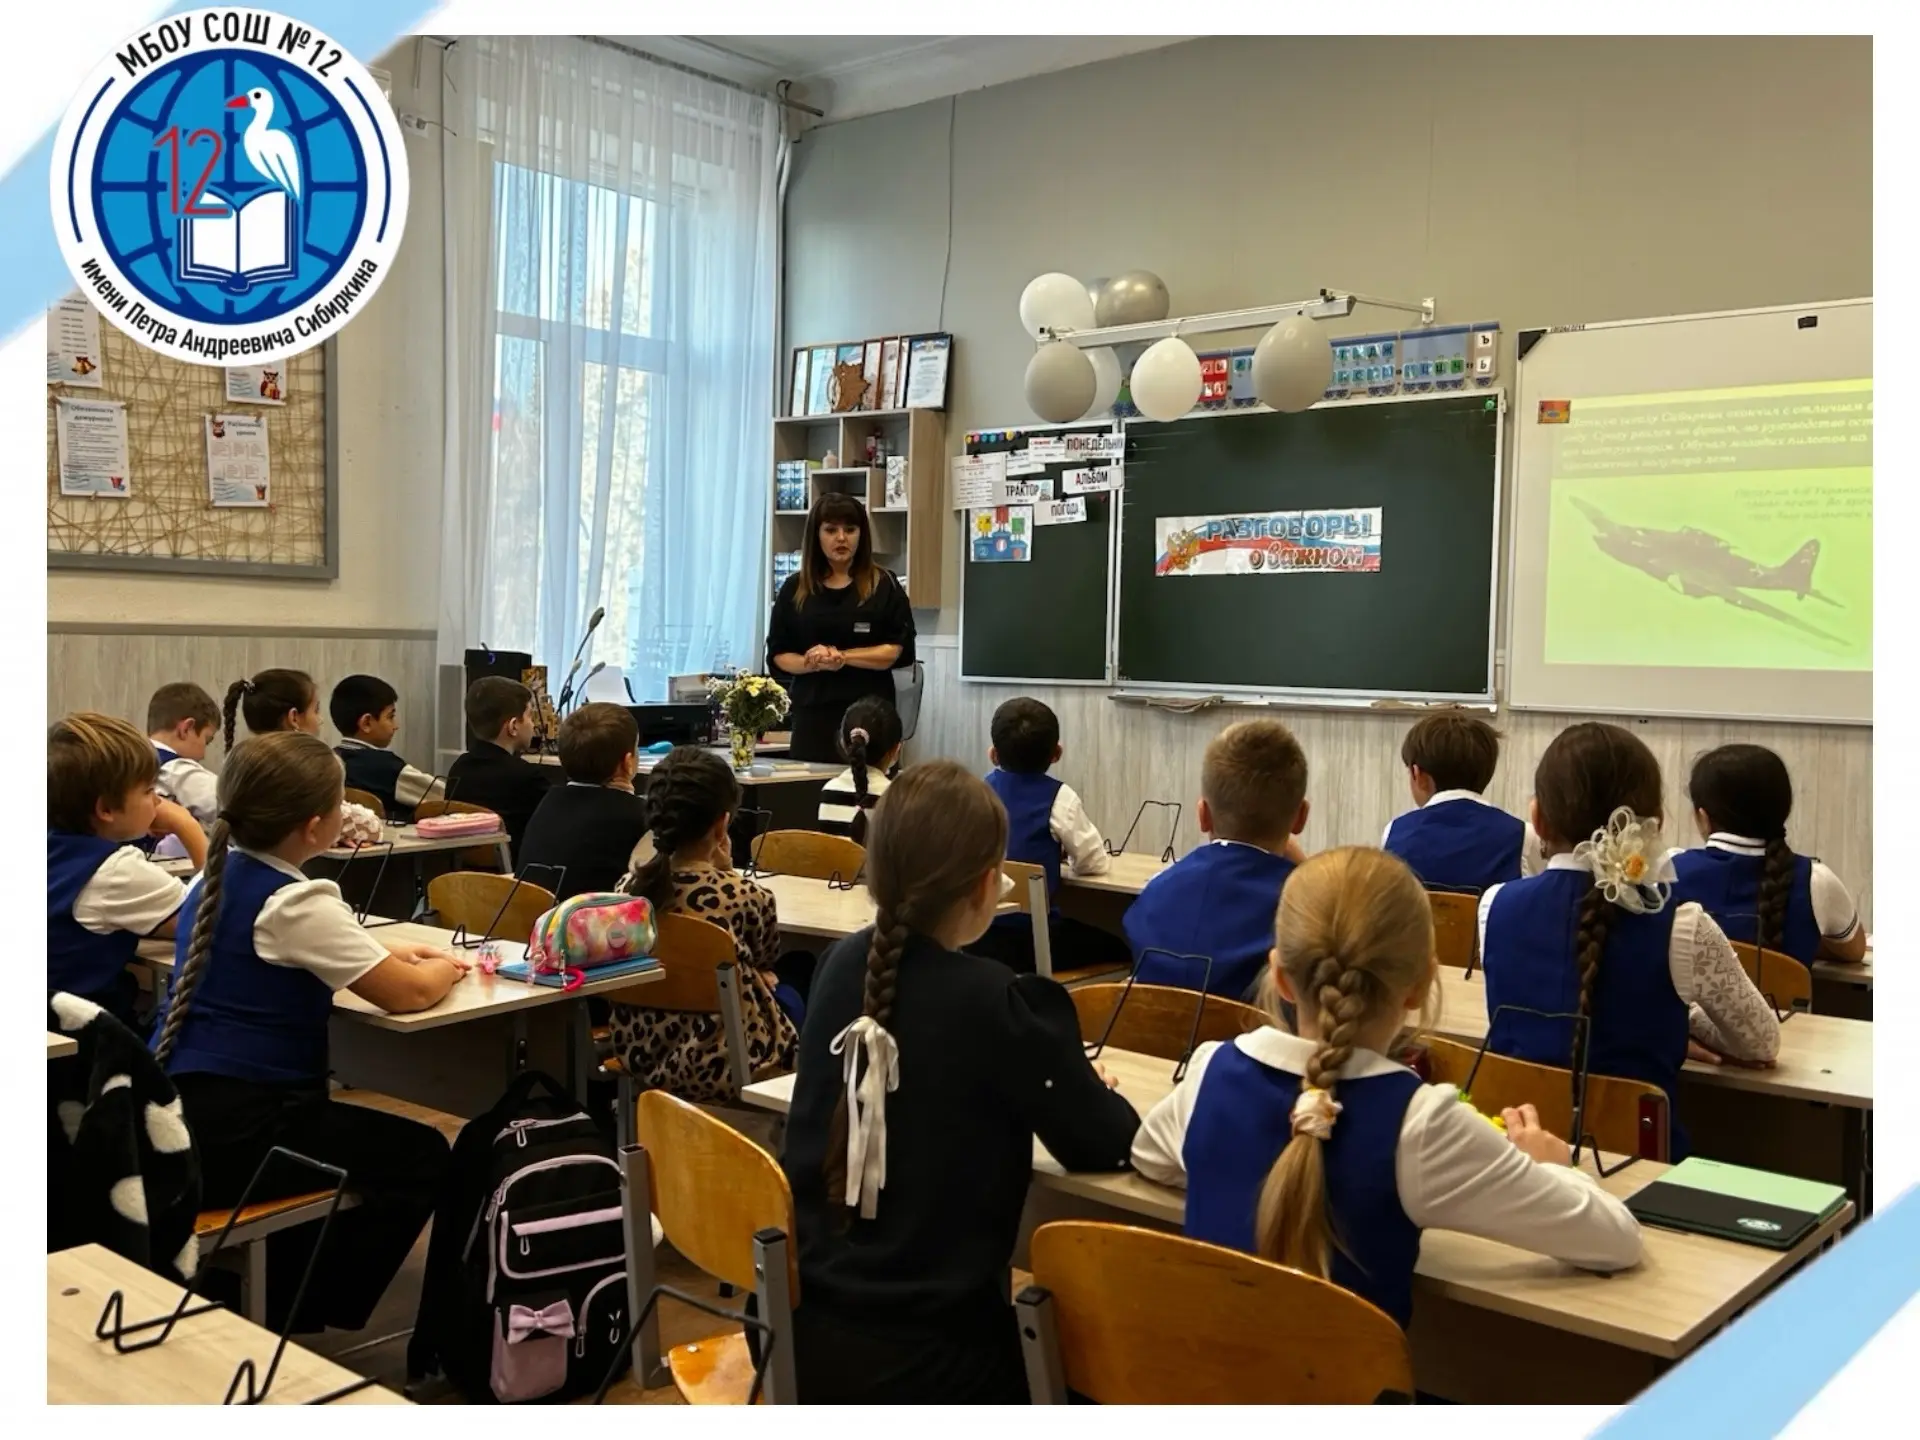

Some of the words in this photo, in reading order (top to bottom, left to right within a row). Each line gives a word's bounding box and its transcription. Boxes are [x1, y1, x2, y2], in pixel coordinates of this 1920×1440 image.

[1075, 471, 1108, 485] АЛЬБОМ
[1005, 483, 1040, 497] ТРАКТОР
[1205, 513, 1373, 542] РАЗГОВОРЫ
